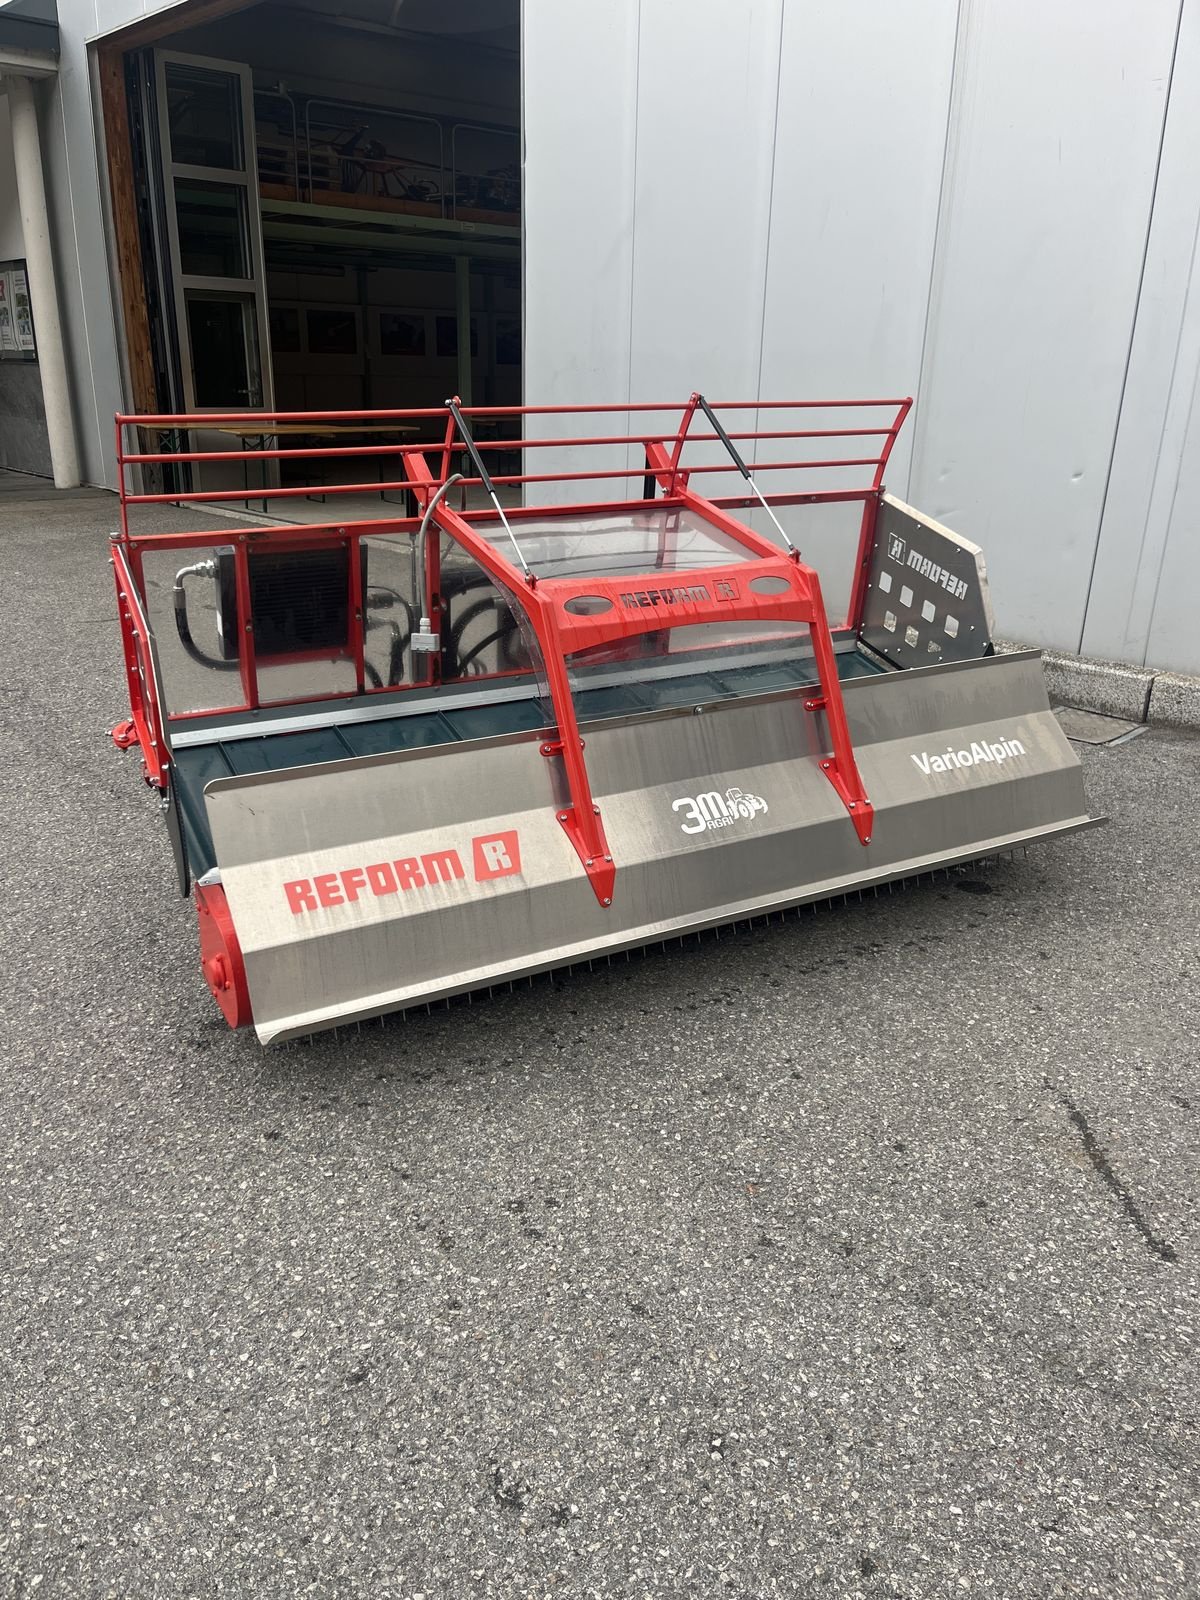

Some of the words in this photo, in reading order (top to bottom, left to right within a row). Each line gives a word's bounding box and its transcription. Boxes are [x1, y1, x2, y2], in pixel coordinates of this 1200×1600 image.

[619, 584, 711, 609] REFORM
[910, 736, 1026, 775] VarioAlpin
[671, 791, 731, 834] 3M
[283, 850, 465, 915] REFORM
